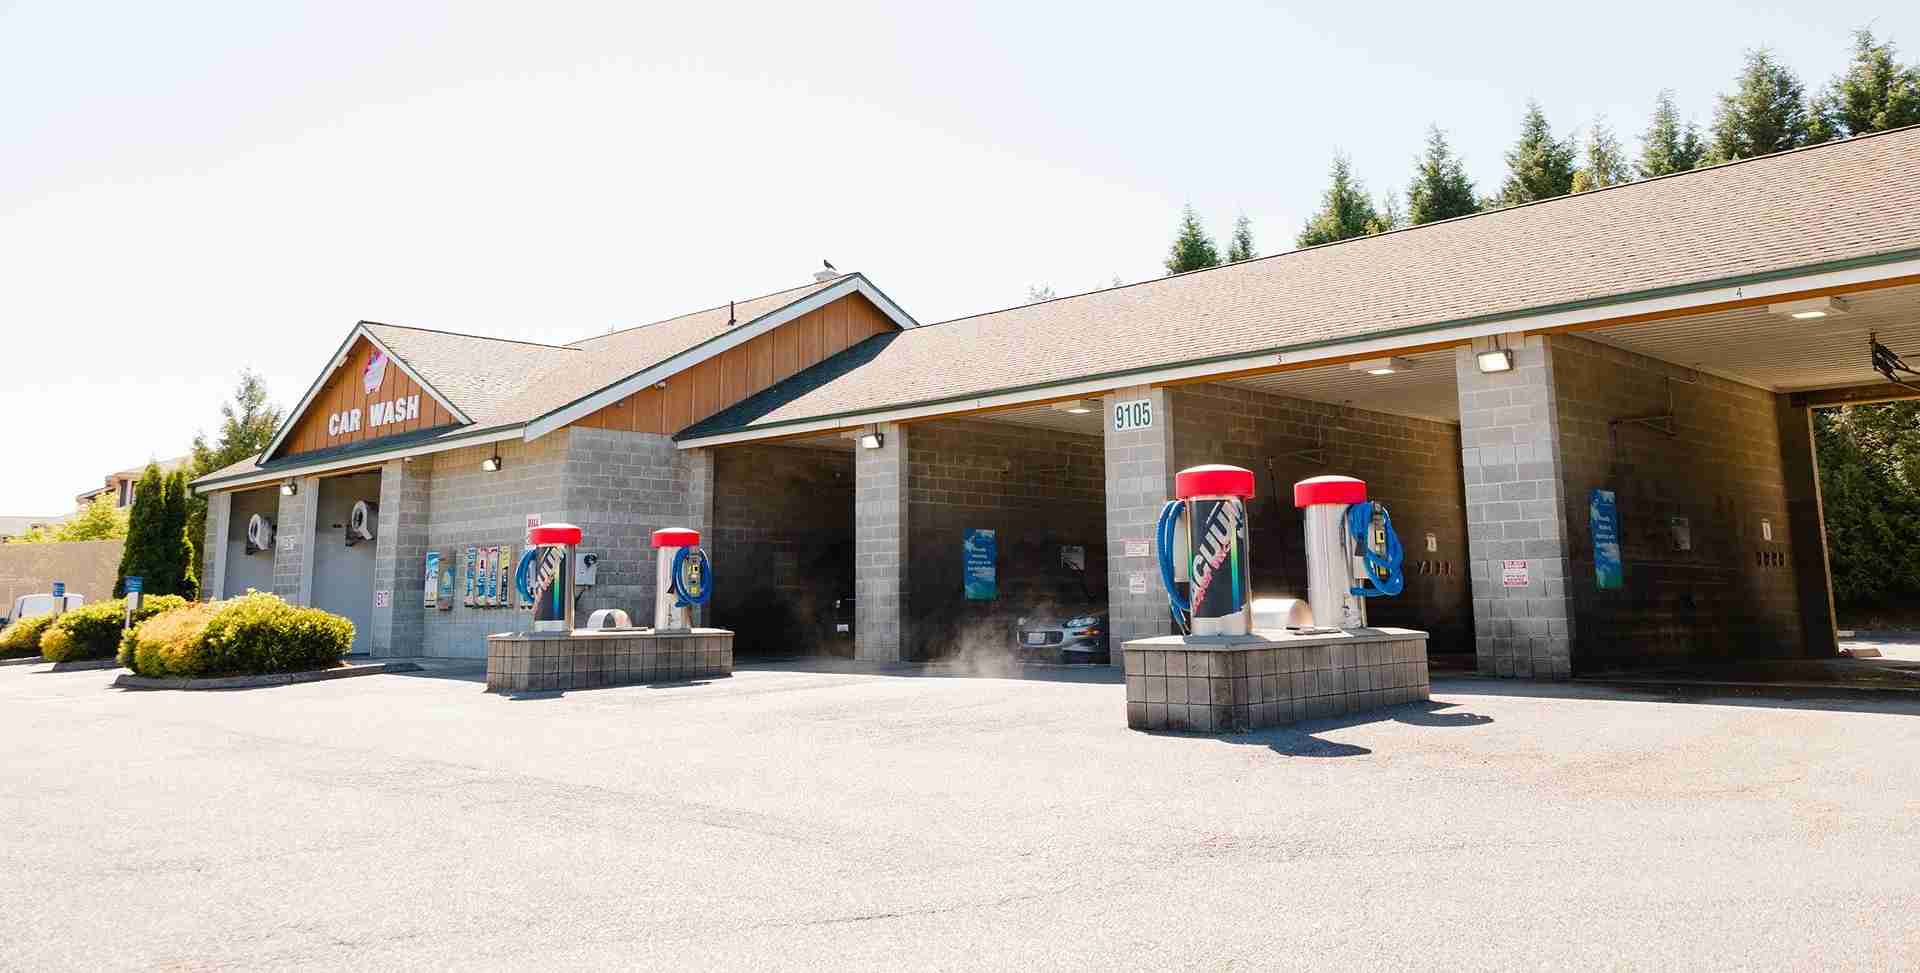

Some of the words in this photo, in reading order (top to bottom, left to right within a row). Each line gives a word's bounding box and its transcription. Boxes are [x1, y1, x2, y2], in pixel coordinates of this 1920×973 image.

[328, 408, 361, 437] CAR
[370, 395, 419, 427] WASH
[1116, 402, 1151, 429] 9105
[1191, 498, 1246, 602] ACUUM
